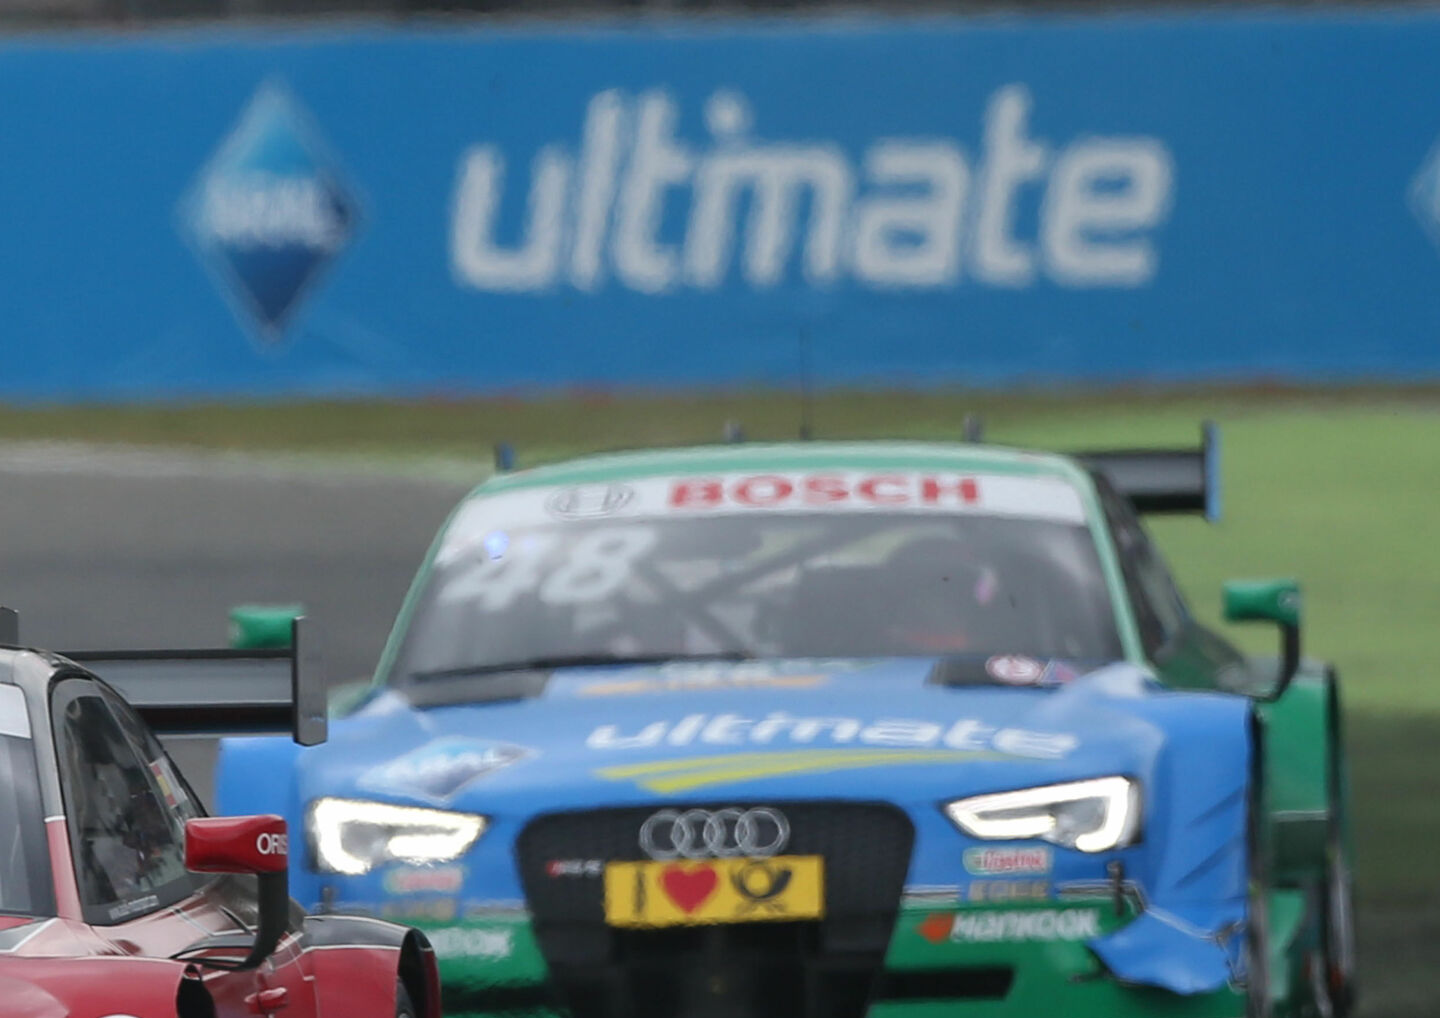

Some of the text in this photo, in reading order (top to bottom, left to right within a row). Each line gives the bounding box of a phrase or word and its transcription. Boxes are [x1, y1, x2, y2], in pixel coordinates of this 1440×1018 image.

[450, 85, 1172, 292] ultimate
[667, 475, 981, 509] BOSCH
[444, 528, 656, 611] 48
[586, 711, 1079, 760] ultimate
